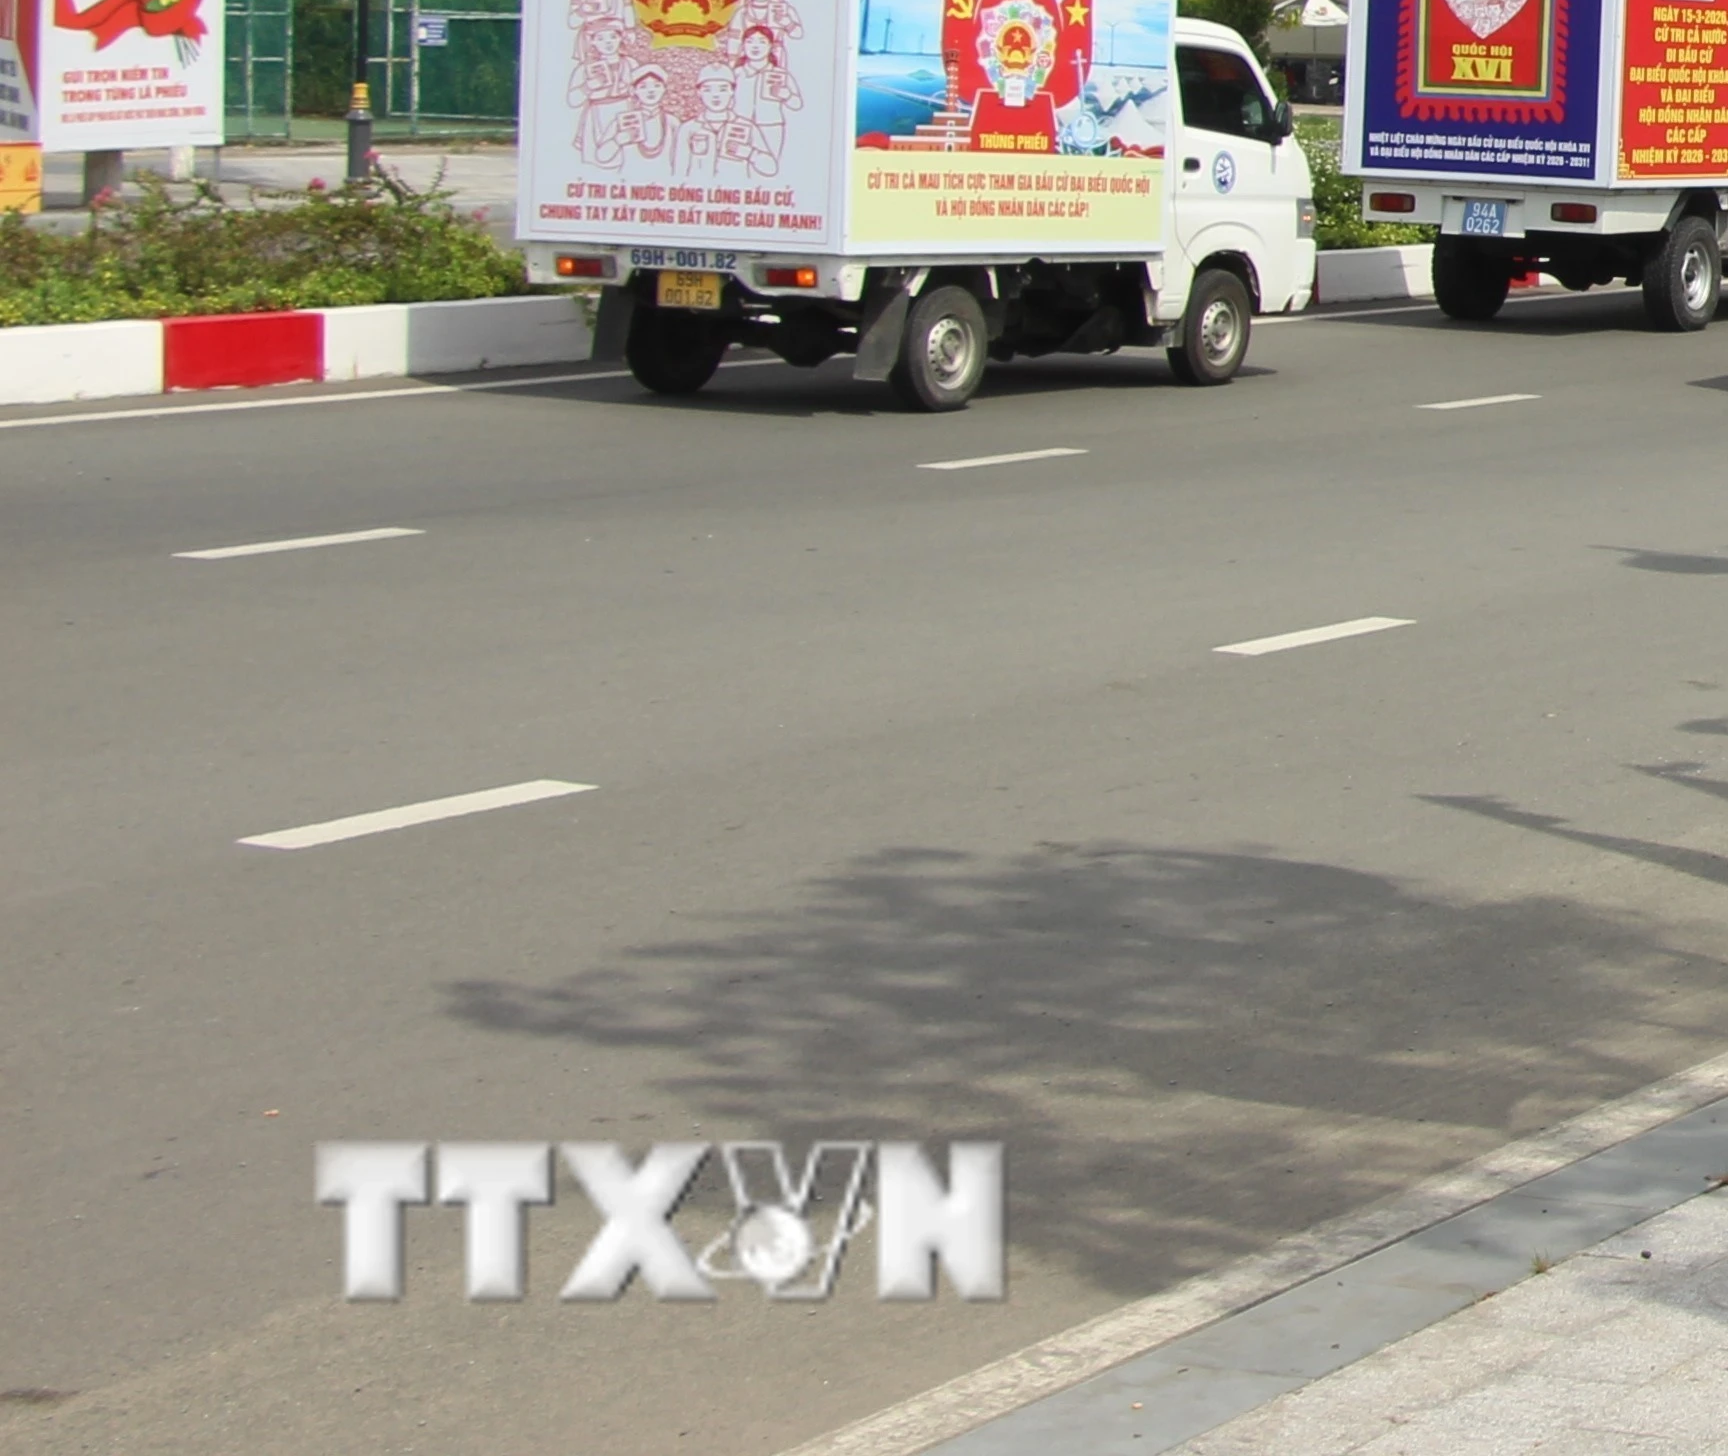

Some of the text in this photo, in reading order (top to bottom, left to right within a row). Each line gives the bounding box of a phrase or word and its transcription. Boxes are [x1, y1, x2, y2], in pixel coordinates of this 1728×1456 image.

[1654, 6, 1728, 27] NGÀY 15-3-2026,
[1655, 26, 1727, 44] CỬ TRI CẢ NƯỚC
[1452, 42, 1513, 57] QUỐC HỘI
[1666, 45, 1713, 63] ĐI BẦU CỬ
[1451, 56, 1513, 83] XVI
[1661, 85, 1714, 105] VÀ ĐẠI BIỂU
[1639, 106, 1656, 125] HỘI
[1658, 106, 1684, 123] ĐỒNG
[1686, 107, 1712, 124] NHÂN
[980, 131, 1048, 150] THÙNG PHIẾU
[1667, 125, 1706, 143] CÁC CẤP
[1632, 147, 1664, 166] NHIỆM
[1666, 147, 1678, 163] KỲ
[1681, 149, 1703, 163] 2026
[567, 178, 794, 207] CỬ TRI CẢ NƯỚC ĐỒNG LÒNG BẦU CỬ,
[540, 204, 821, 232] CHUNG TAY XÂY DỰNG ĐẤT NƯỚC GIÀU MẠNH!
[1473, 203, 1496, 218] 94A
[1466, 218, 1500, 234] 0262
[676, 272, 703, 286] 69H
[664, 289, 713, 306] 001.82
